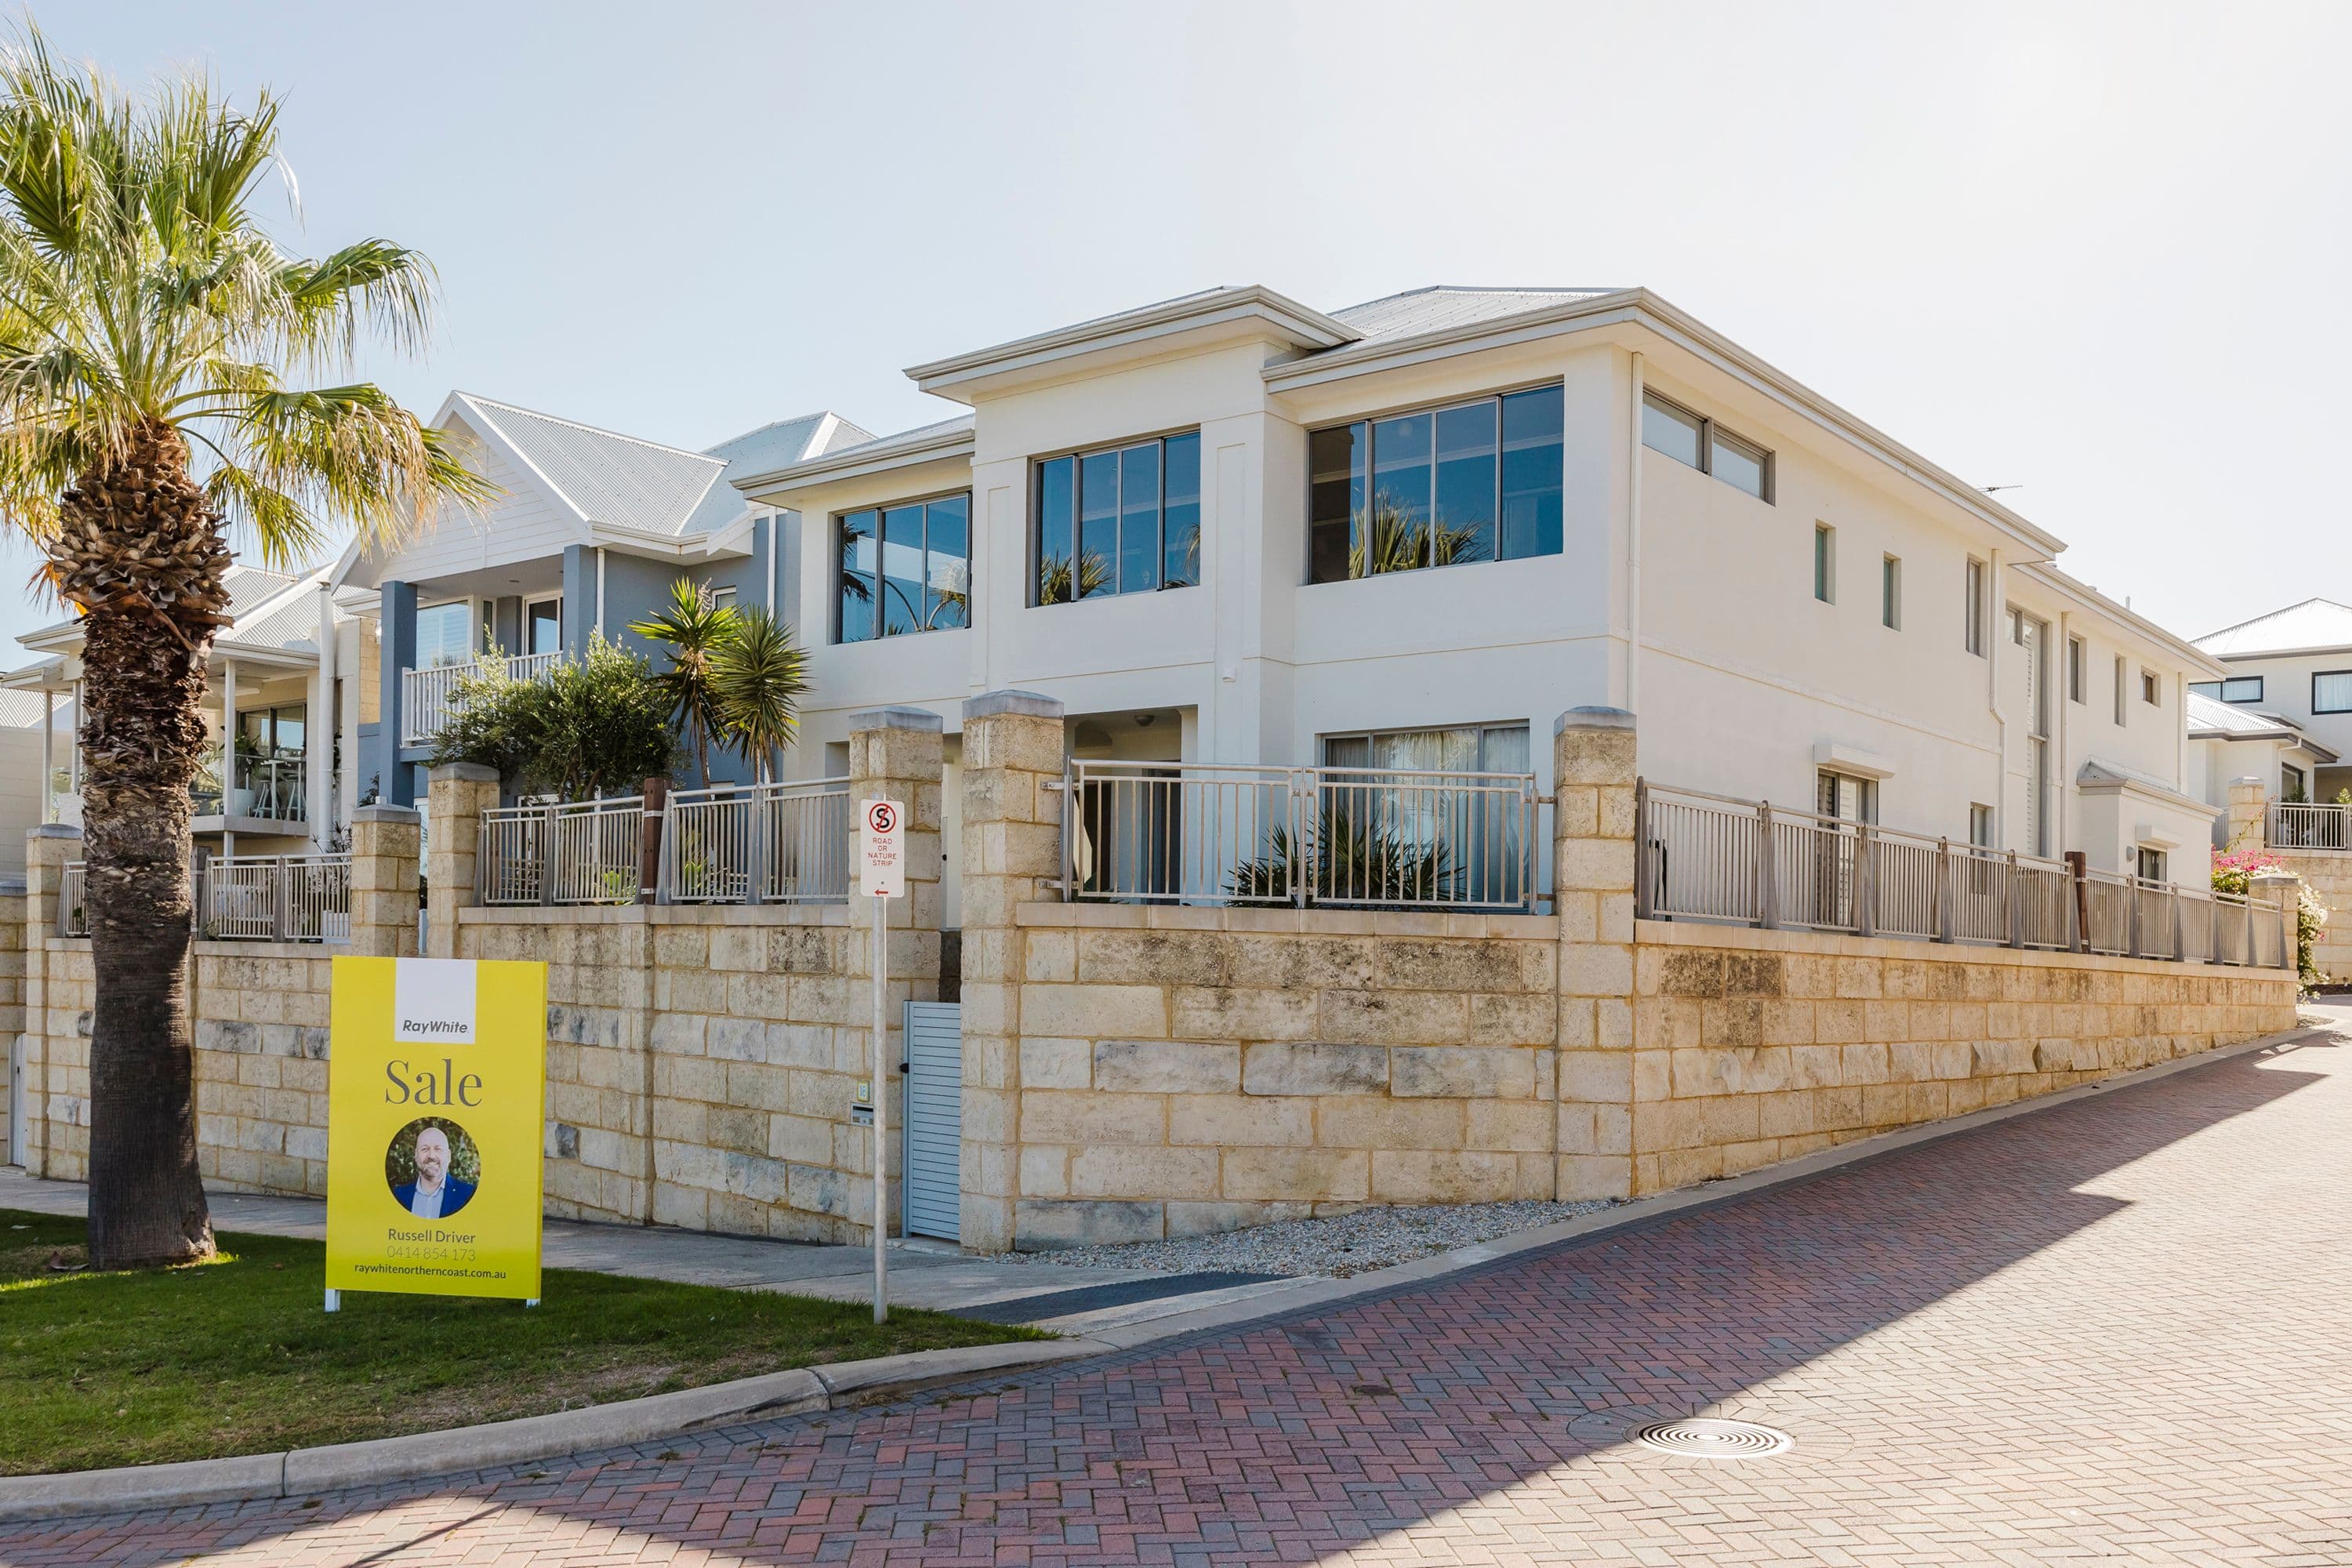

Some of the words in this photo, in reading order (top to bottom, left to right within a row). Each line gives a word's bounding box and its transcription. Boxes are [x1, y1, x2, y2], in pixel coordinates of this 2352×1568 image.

[402, 1019, 468, 1035] RayWhite
[385, 1058, 483, 1107] Sale
[388, 1228, 432, 1243] Russell
[435, 1230, 477, 1244] Driver
[387, 1245, 421, 1259] 0414
[423, 1247, 448, 1261] 854
[452, 1248, 477, 1262] 173
[354, 1263, 506, 1279] raywhitenortherncoast.com.au
